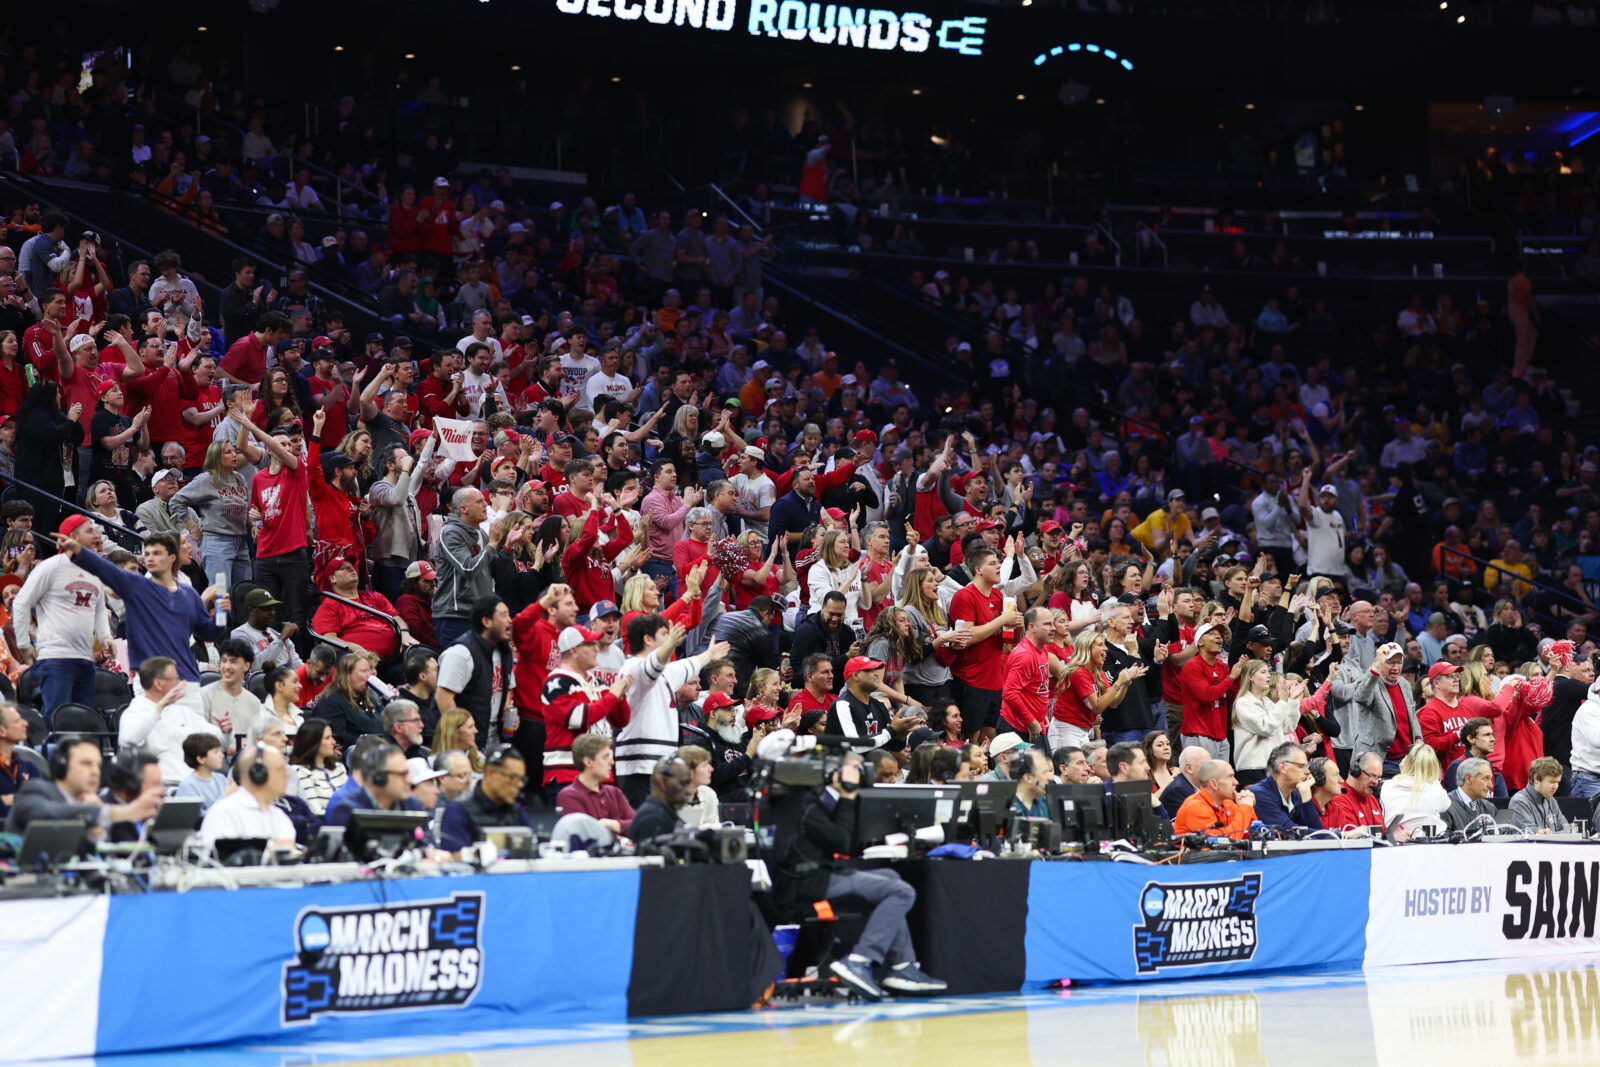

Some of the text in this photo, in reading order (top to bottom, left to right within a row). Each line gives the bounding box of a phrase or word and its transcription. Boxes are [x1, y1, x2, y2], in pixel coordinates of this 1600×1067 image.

[748, 0, 932, 52] ROUNDS
[74, 591, 92, 608] M
[1162, 887, 1231, 919] MARCH
[1405, 860, 1600, 940] HOSTED BY SAIN
[324, 908, 431, 954] MARCH
[1170, 916, 1255, 953] MADNESS
[338, 948, 480, 997] MADNESS
